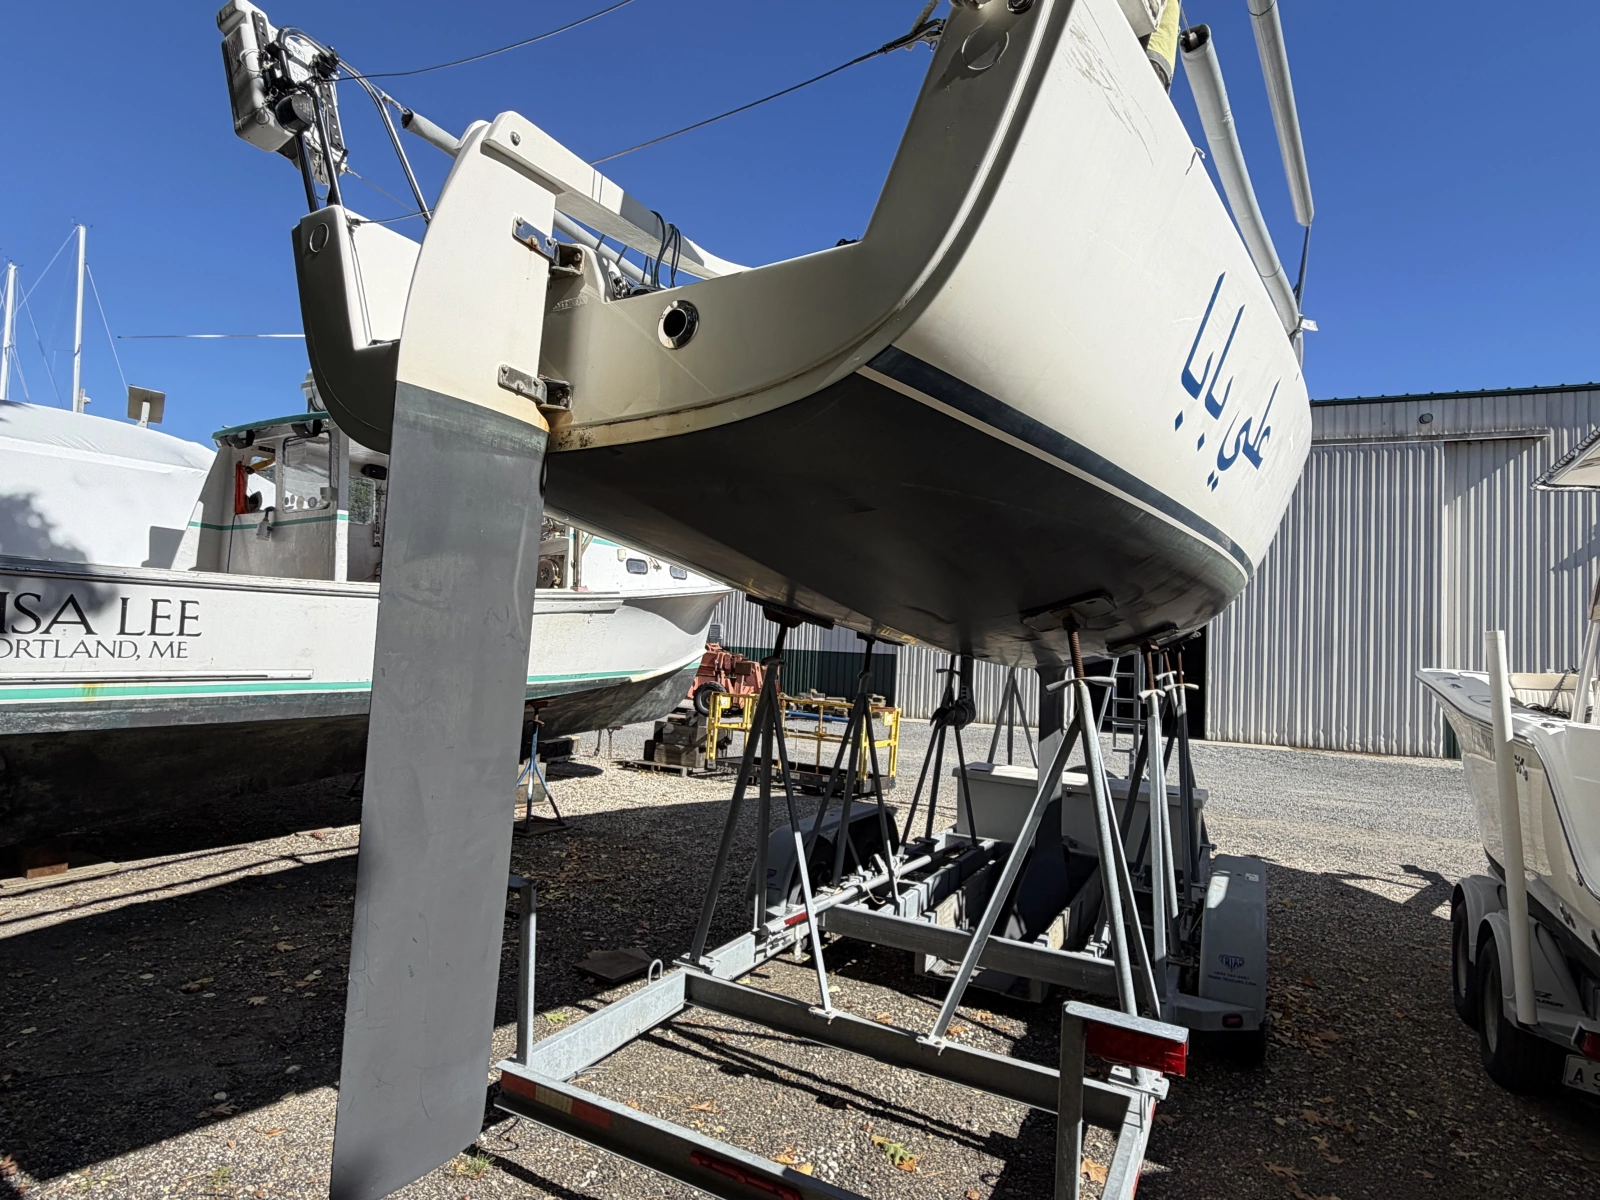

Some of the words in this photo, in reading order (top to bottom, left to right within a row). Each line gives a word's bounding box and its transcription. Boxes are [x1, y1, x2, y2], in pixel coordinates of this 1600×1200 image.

[116, 597, 202, 637] LEE
[148, 640, 188, 659] ME
[1219, 955, 1245, 971] TRIAD
